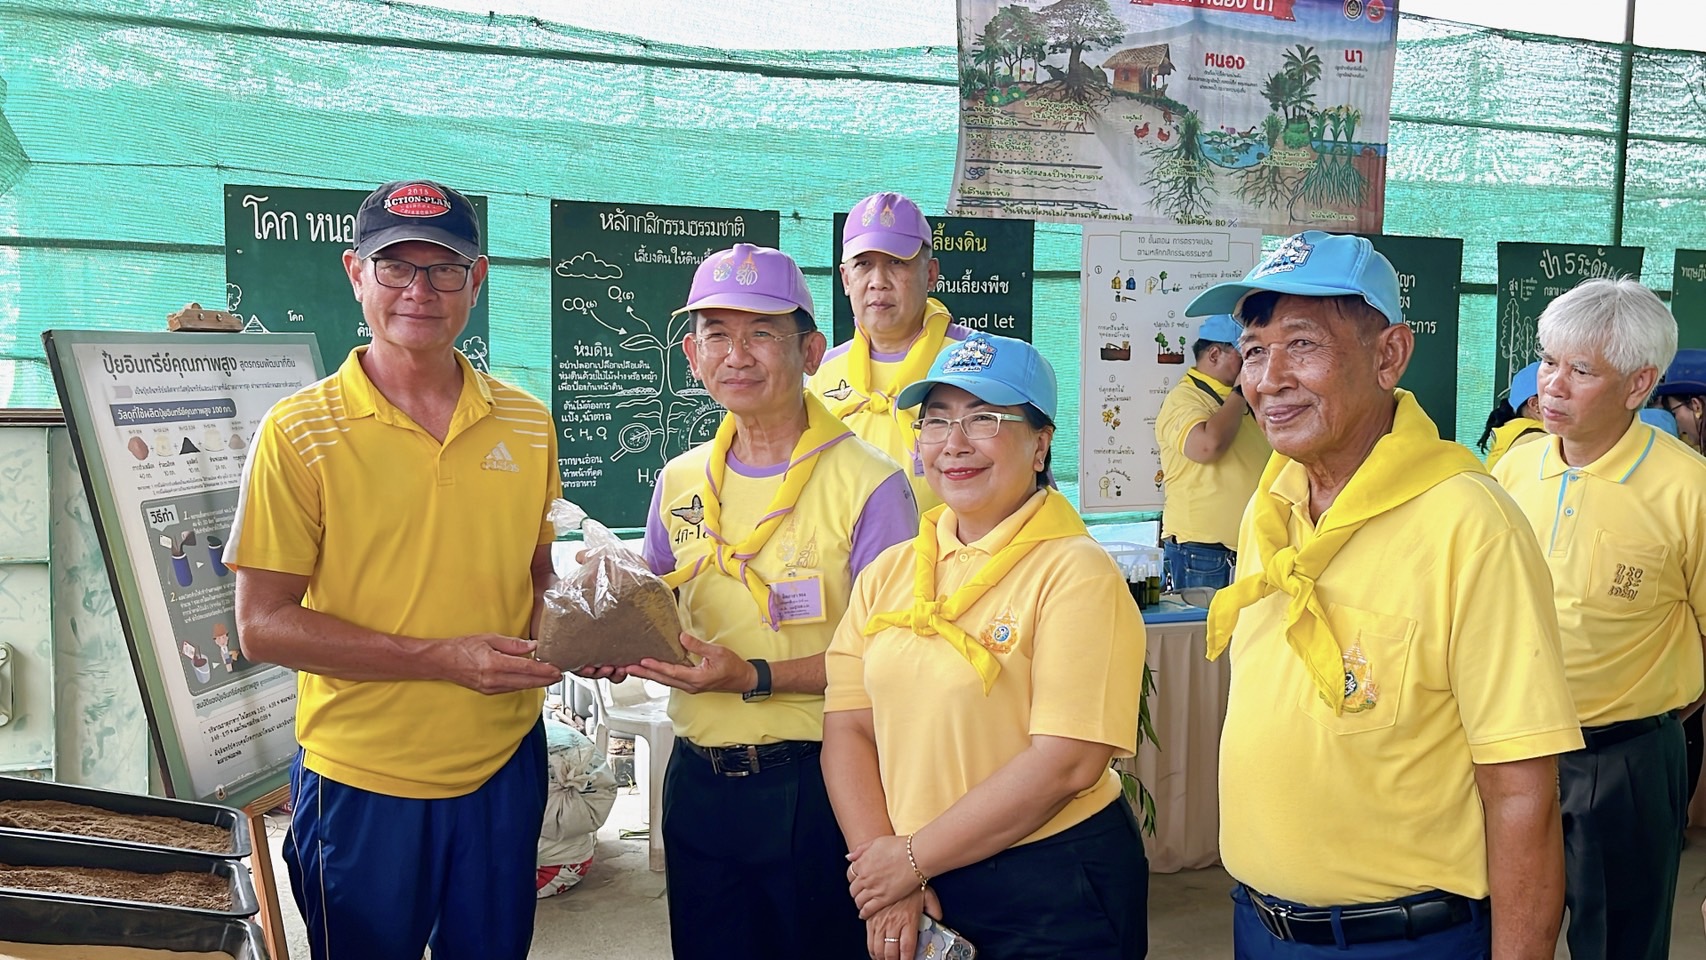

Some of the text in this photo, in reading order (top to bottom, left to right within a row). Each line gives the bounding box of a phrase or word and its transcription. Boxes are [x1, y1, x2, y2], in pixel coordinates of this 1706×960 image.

[1205, 52, 1245, 70] หนอง
[1345, 49, 1363, 63] นา
[407, 188, 429, 196] 2015
[383, 195, 452, 210] ACTION-PLAN
[242, 194, 357, 243] โคก หนอ
[600, 208, 745, 238] หลักกสิกรรมธรรมชาติ
[1215, 219, 1226, 227] 80
[932, 223, 987, 252] ลี้ยงดิน
[1138, 236, 1146, 244] 10
[1540, 248, 1561, 279] ป่า
[1564, 253, 1576, 275] 5
[930, 268, 1010, 294] ดินเลี้ยงพืช
[287, 309, 304, 322] โคก
[959, 313, 1015, 328] and let
[574, 340, 613, 357] ห่มดิน
[102, 349, 238, 380] ปุ๋ยอินทรีย์คุณภาพสูง
[212, 406, 223, 414] 100
[149, 507, 176, 525] วิธีทำ
